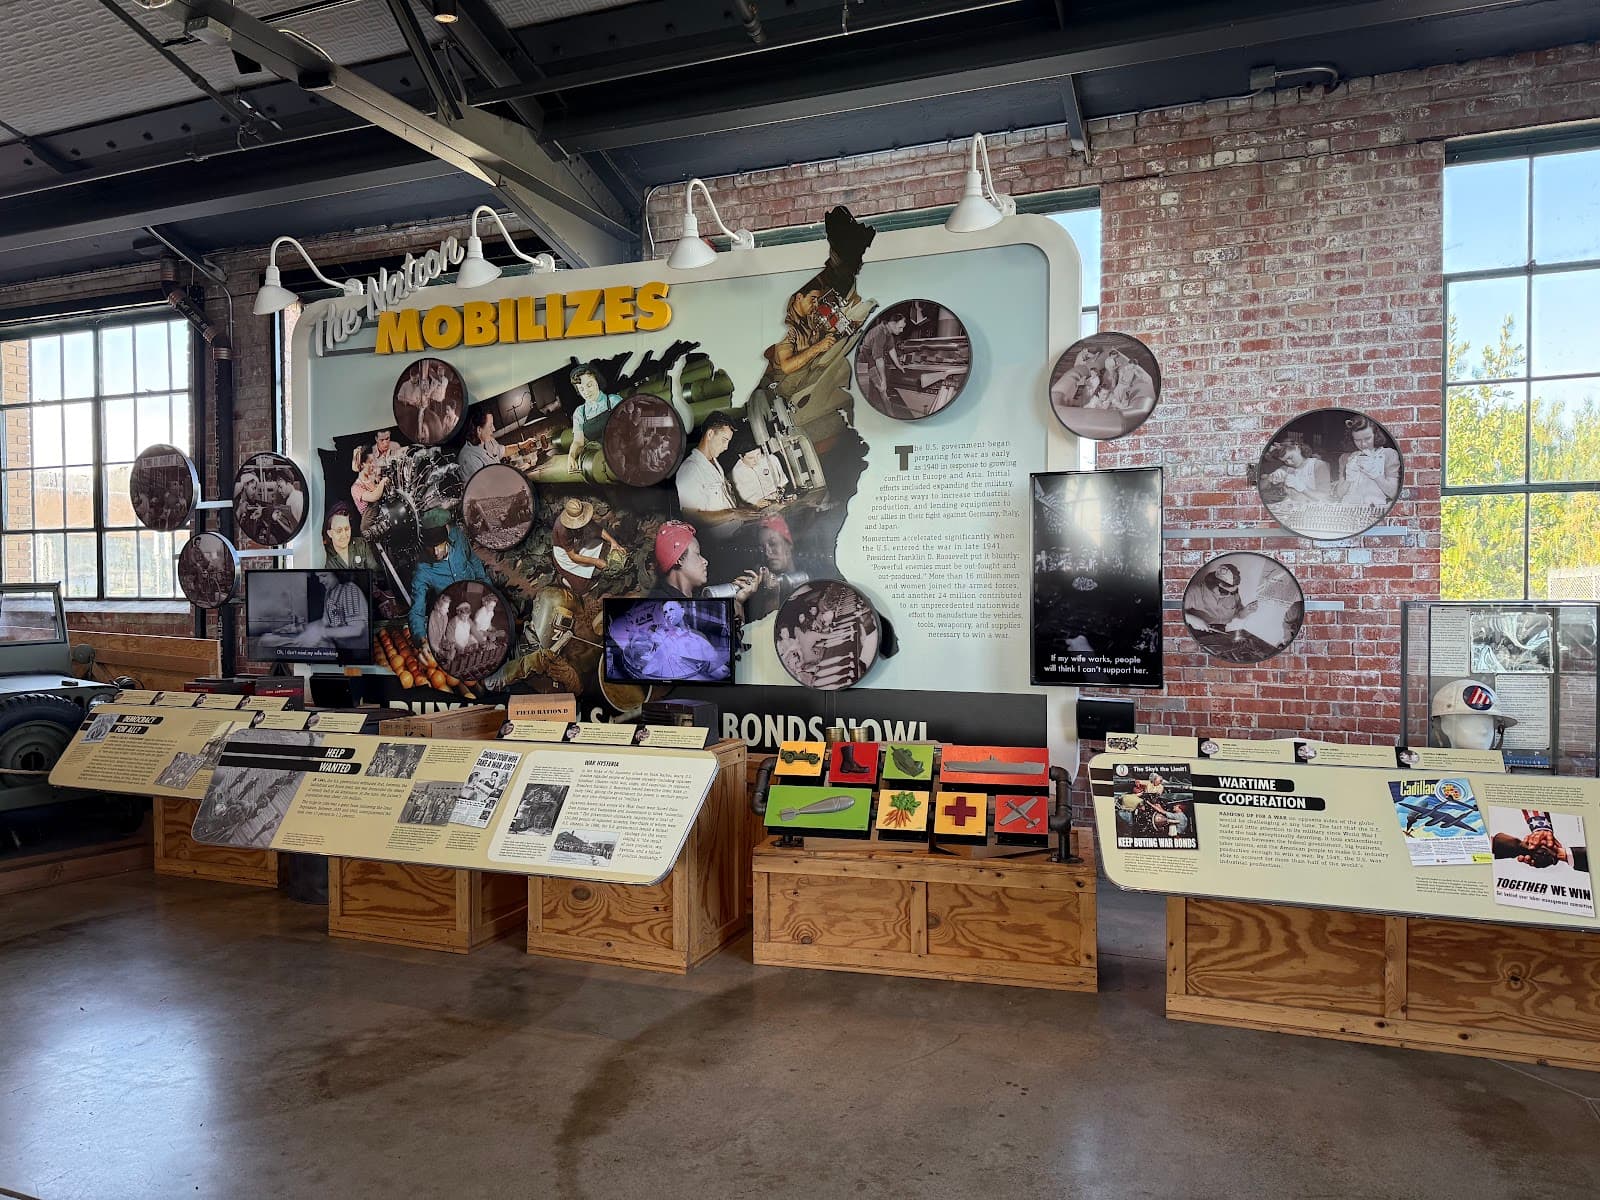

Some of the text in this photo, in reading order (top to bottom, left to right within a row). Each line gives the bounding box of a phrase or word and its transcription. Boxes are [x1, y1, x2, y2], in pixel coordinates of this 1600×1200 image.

[315, 235, 465, 357] The Nation
[374, 281, 673, 355] MOBILIZES
[941, 441, 985, 452] government
[988, 440, 1010, 448] began
[914, 453, 948, 462] preparing
[992, 450, 1010, 458] early
[987, 470, 1010, 478] Initial
[932, 481, 968, 490] expanding
[876, 494, 908, 502] exploring
[930, 502, 958, 510] lending
[960, 500, 1000, 509] equipment
[942, 511, 967, 520] against
[945, 533, 990, 542] significantly
[992, 552, 1020, 560] bluntly:
[928, 582, 952, 590] joined
[992, 622, 1021, 630] supplies
[1058, 656, 1068, 664] my
[1070, 654, 1086, 662] wife
[1088, 654, 1112, 664] works,
[1114, 656, 1141, 664] people
[1058, 664, 1076, 672] think
[1134, 666, 1148, 674] her.
[123, 714, 157, 724] DEMOCRACY
[114, 725, 126, 733] FOR
[722, 712, 825, 748] BONDS
[325, 748, 346, 758] HELP
[482, 750, 498, 760] SHOULD
[476, 758, 488, 766] TAKE
[318, 762, 351, 774] WANTED
[1218, 777, 1276, 791] WARTIME
[1401, 779, 1436, 796] Cadillac
[1218, 793, 1306, 809] COOPERATION
[1118, 837, 1196, 848] KEEP BUYING WAR BONDS
[1496, 878, 1548, 895] TOGETHER
[1550, 884, 1567, 897] WE
[1568, 887, 1591, 900] WIN
